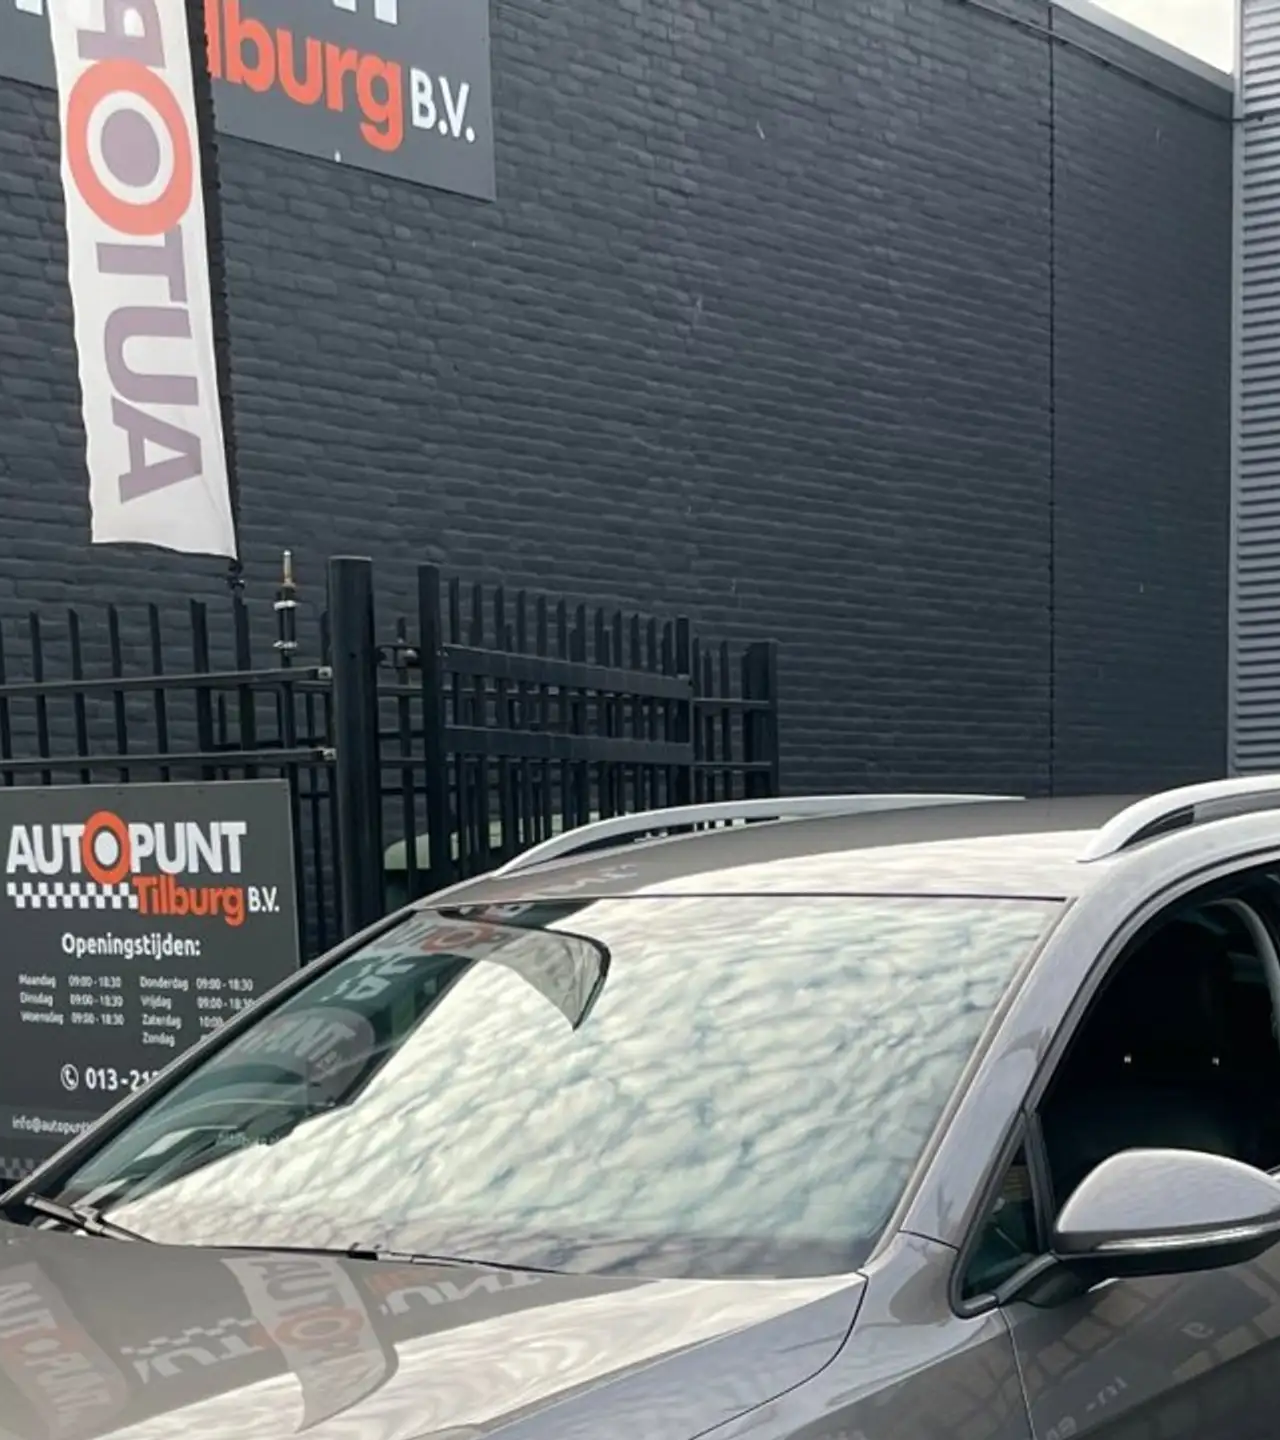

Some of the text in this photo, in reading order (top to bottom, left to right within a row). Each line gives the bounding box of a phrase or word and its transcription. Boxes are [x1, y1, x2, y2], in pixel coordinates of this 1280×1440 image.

[204, 0, 476, 152] lburg B.V.
[6, 810, 247, 884] AUTOPUNT
[132, 874, 280, 926] Tilburg B.V.
[61, 932, 201, 960] Openingstijden:
[139, 976, 189, 991] Donderdag
